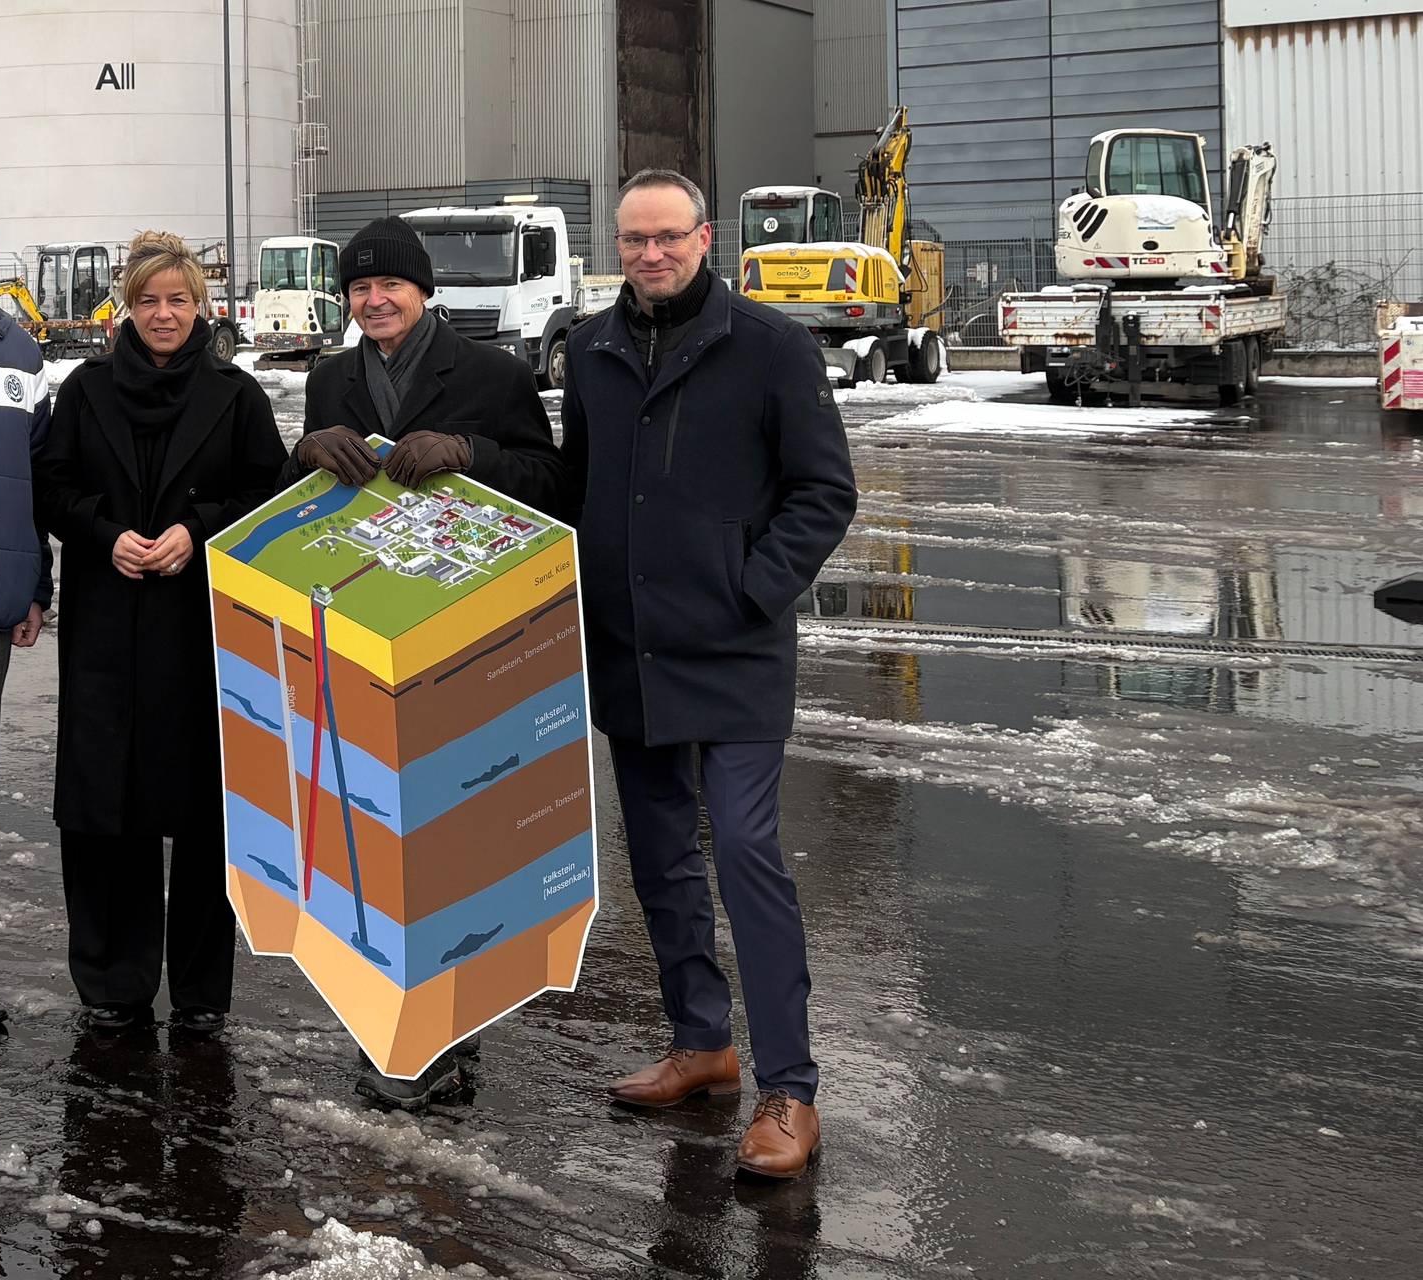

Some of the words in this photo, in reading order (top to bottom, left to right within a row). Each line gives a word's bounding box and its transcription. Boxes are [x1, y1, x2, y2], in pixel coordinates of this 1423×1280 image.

[1132, 257, 1165, 265] TC50
[555, 560, 570, 575] Kies
[487, 656, 523, 681] Sandstein,
[525, 638, 556, 660] Tonstein,
[556, 624, 577, 641] Kohle
[535, 703, 567, 727] Kalkstein
[517, 804, 554, 829] Sandstein,
[555, 787, 585, 808] Tonstein
[543, 862, 575, 885] Kalkstein
